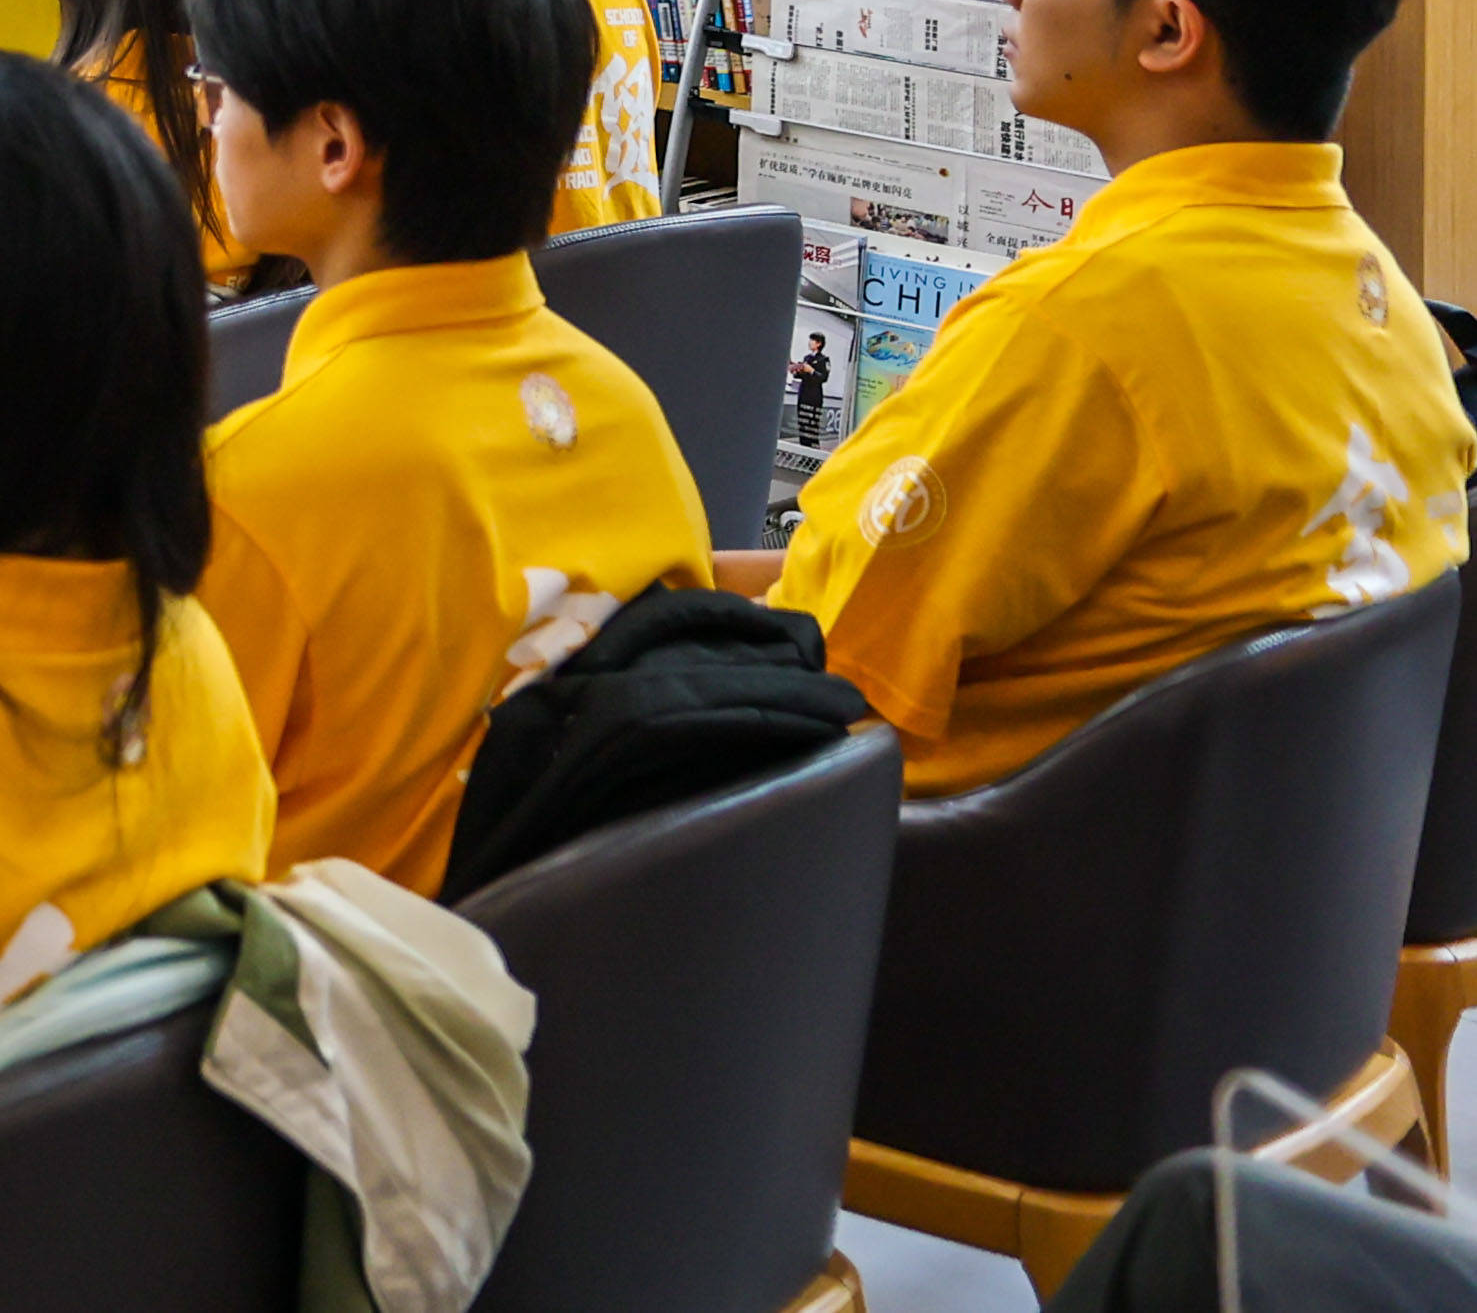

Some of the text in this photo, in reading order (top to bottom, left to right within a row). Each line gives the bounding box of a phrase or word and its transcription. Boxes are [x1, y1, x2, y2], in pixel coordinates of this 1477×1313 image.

[605, 7, 646, 26] SCHOOL
[1021, 188, 1075, 220] 今日
[868, 263, 947, 290] LIVING
[863, 278, 959, 319] CHI
